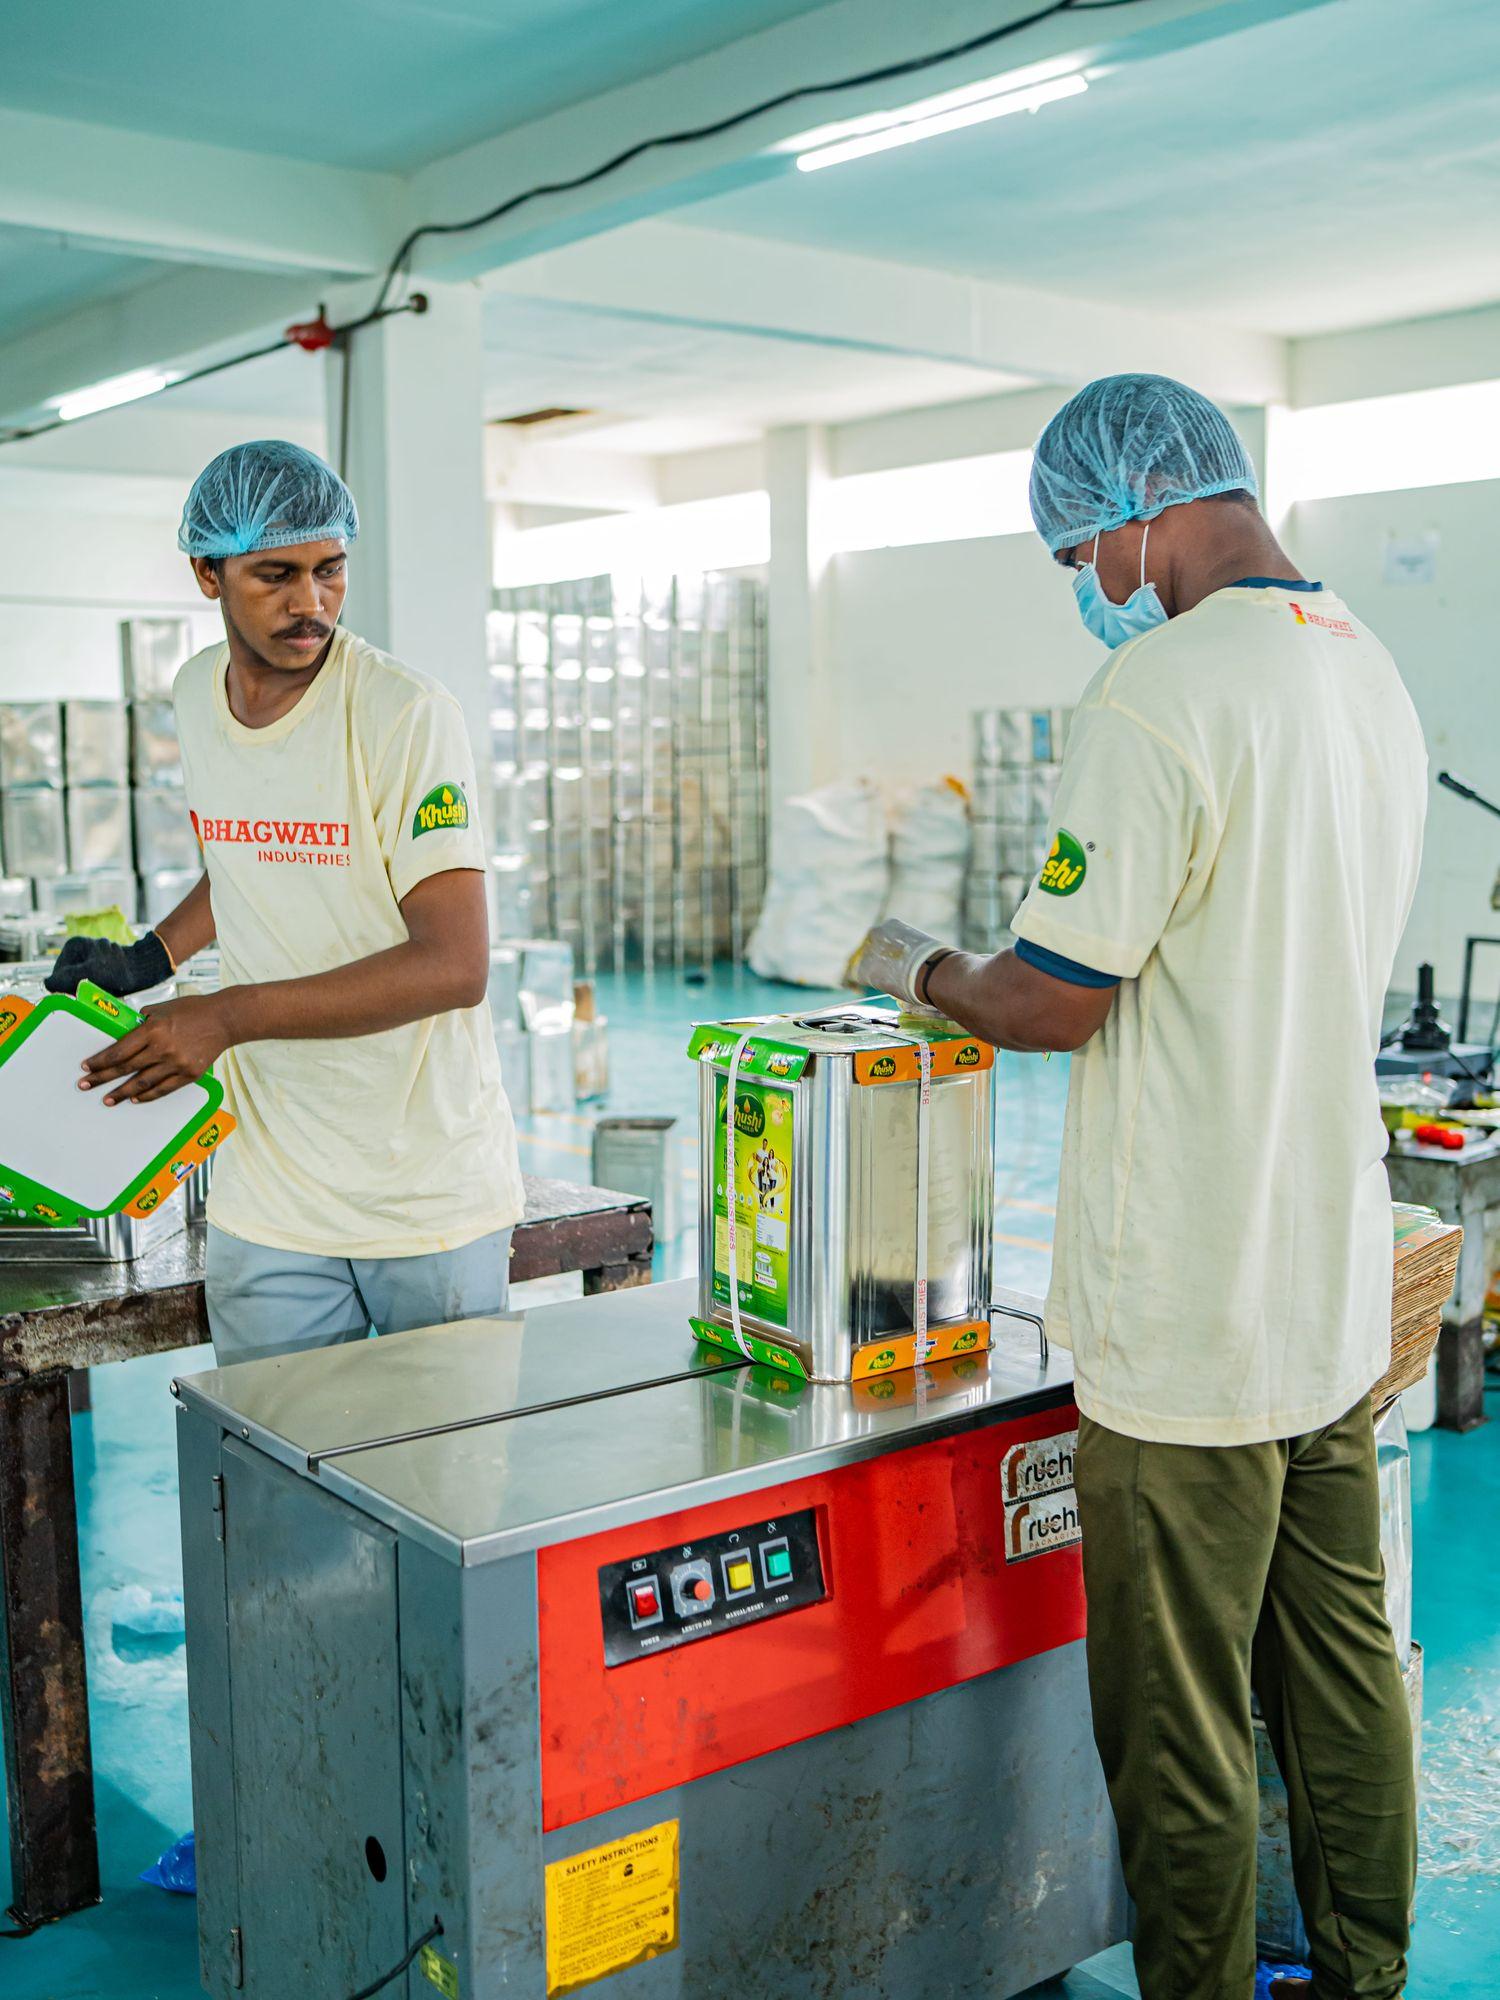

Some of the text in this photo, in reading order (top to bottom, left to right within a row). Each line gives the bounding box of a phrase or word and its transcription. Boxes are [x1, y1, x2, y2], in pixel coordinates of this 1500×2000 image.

[417, 799, 467, 829] Khushi
[202, 819, 349, 847] BHAGWATI
[257, 850, 350, 867] INDUSTRIES
[918, 1279, 926, 1347] INDUSTRIES
[1025, 1475, 1072, 1493] PACKAGIN
[566, 1835, 659, 1876] SAFETY INSTRUCTIONS
